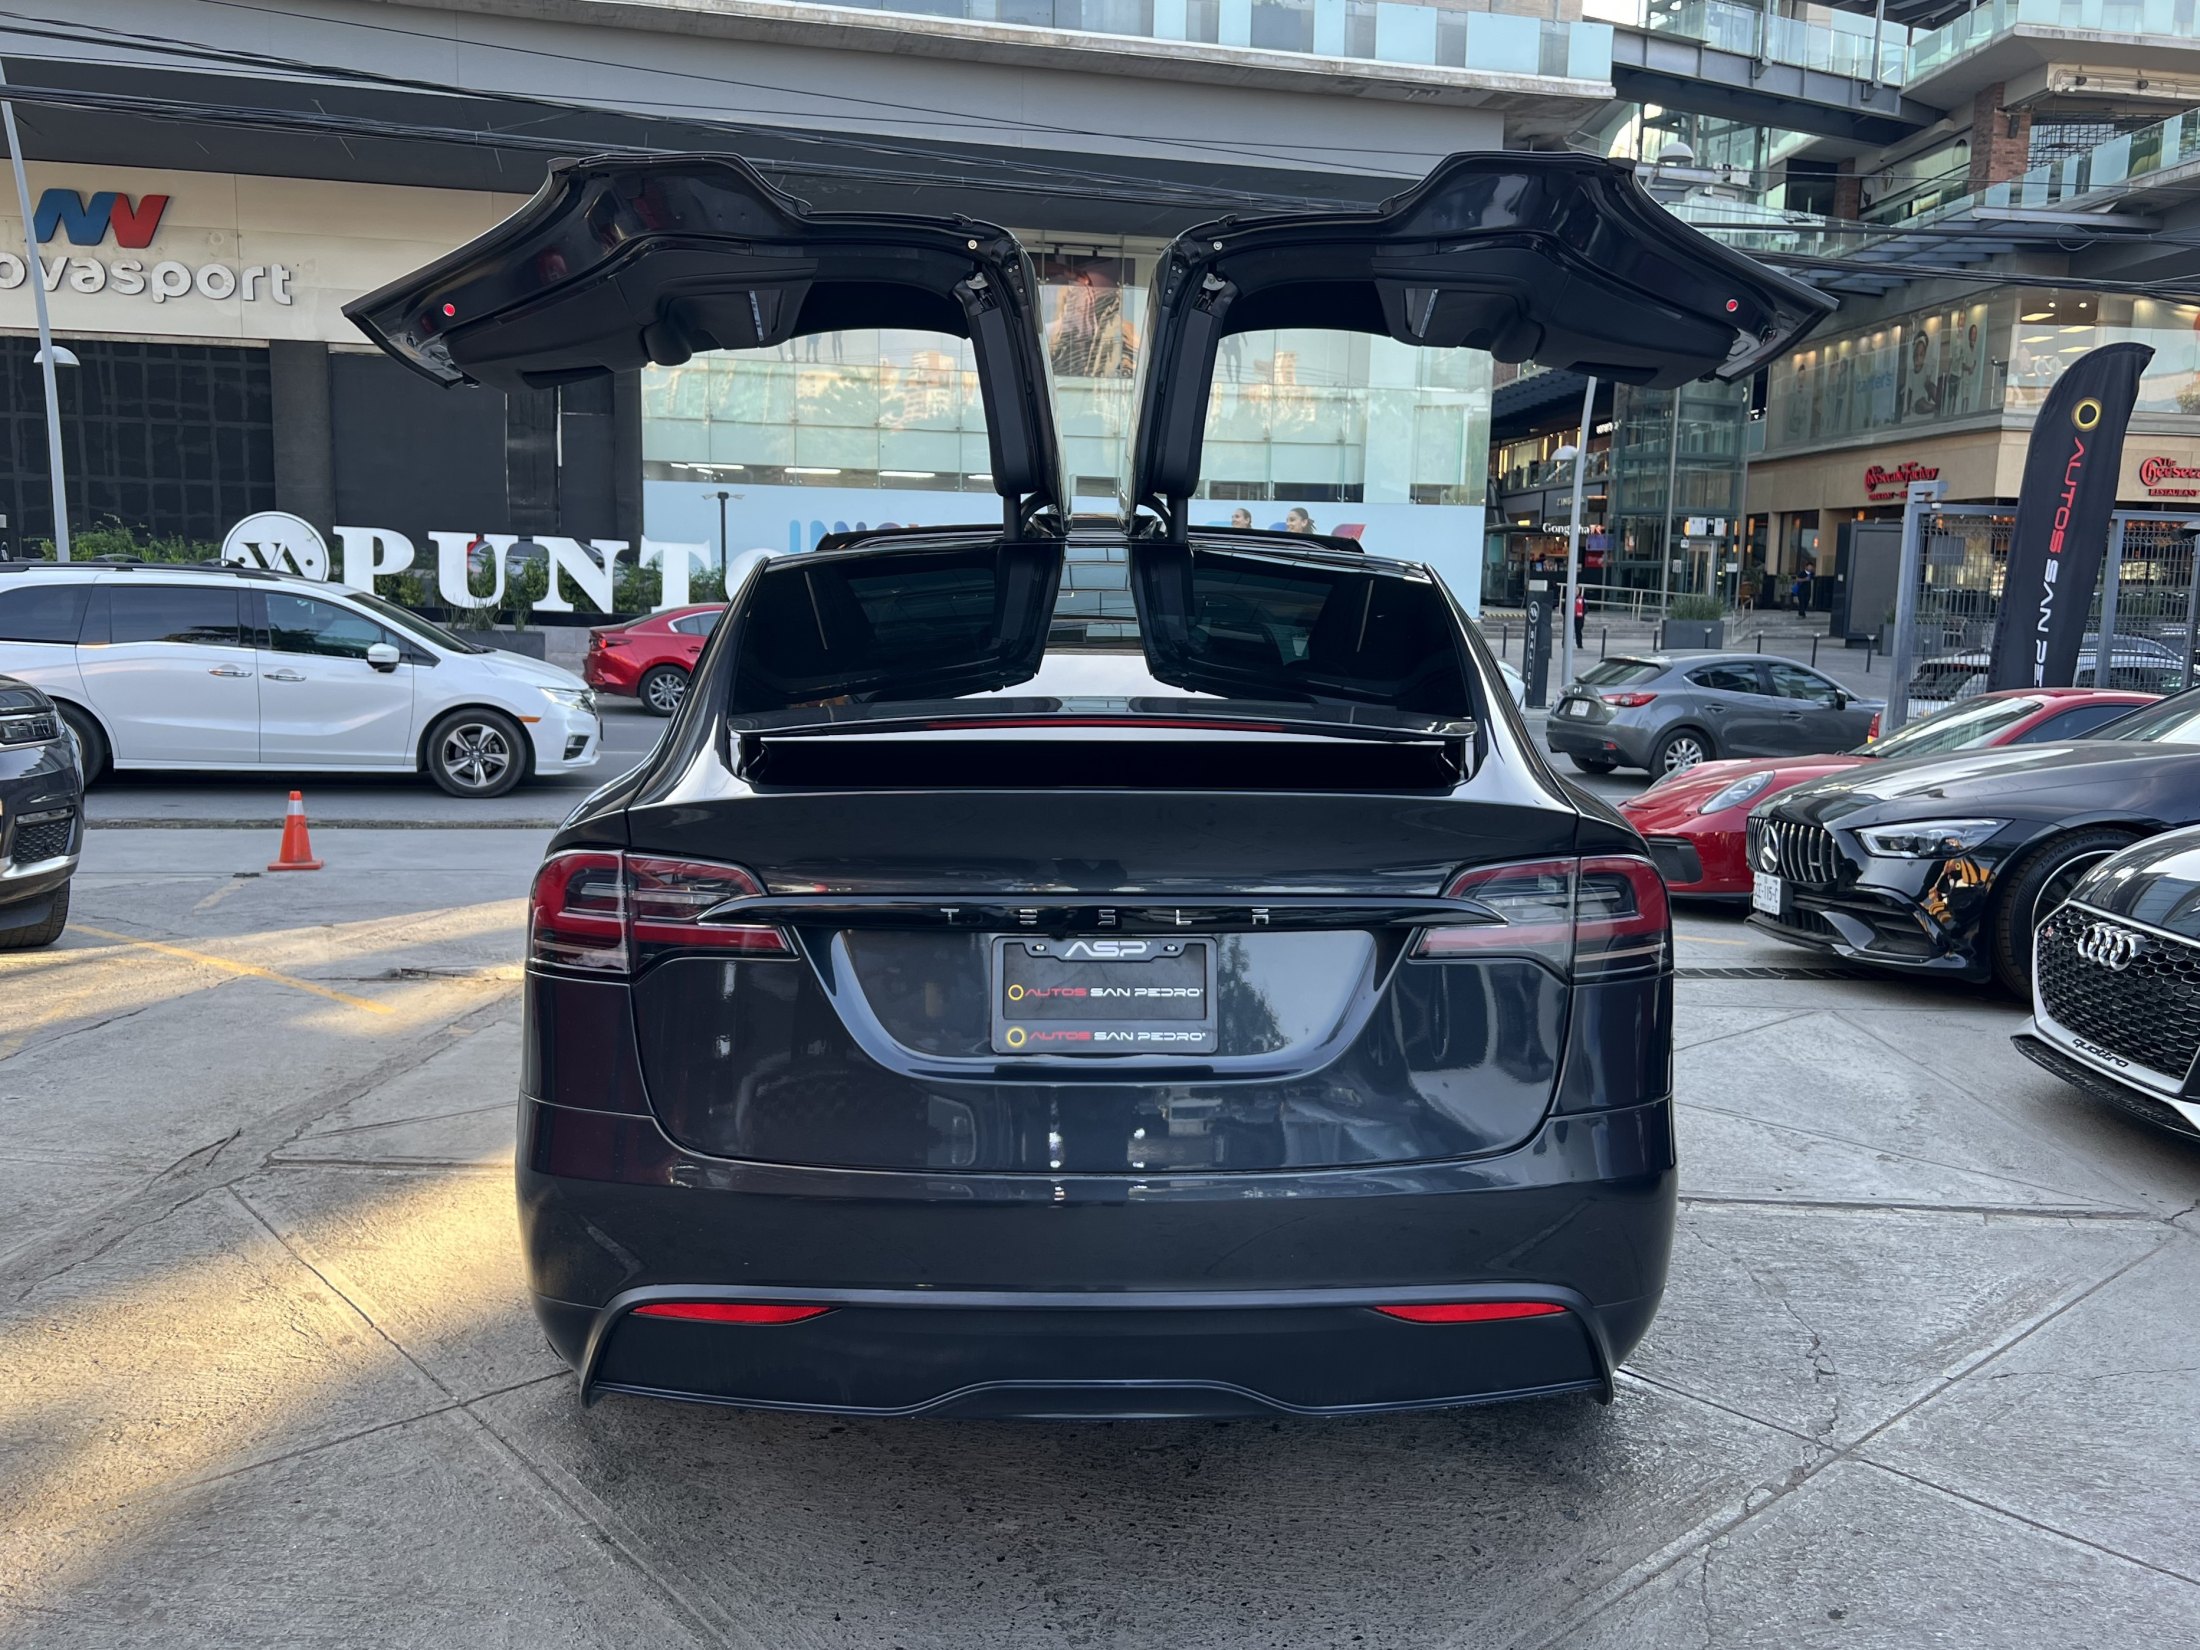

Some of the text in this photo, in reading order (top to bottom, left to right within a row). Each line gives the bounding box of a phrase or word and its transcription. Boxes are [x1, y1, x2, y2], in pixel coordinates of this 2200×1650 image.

[2049, 437, 2085, 554] AUTOS
[2037, 558, 2059, 632] SAN
[940, 908, 1269, 925] TESLA
[1065, 940, 1148, 957] ASP
[1025, 988, 1200, 997] AUTOS SAN PEDRO
[1029, 1032, 1203, 1041] AUTOS SAN PEDRO
[2072, 1038, 2129, 1068] quattro
